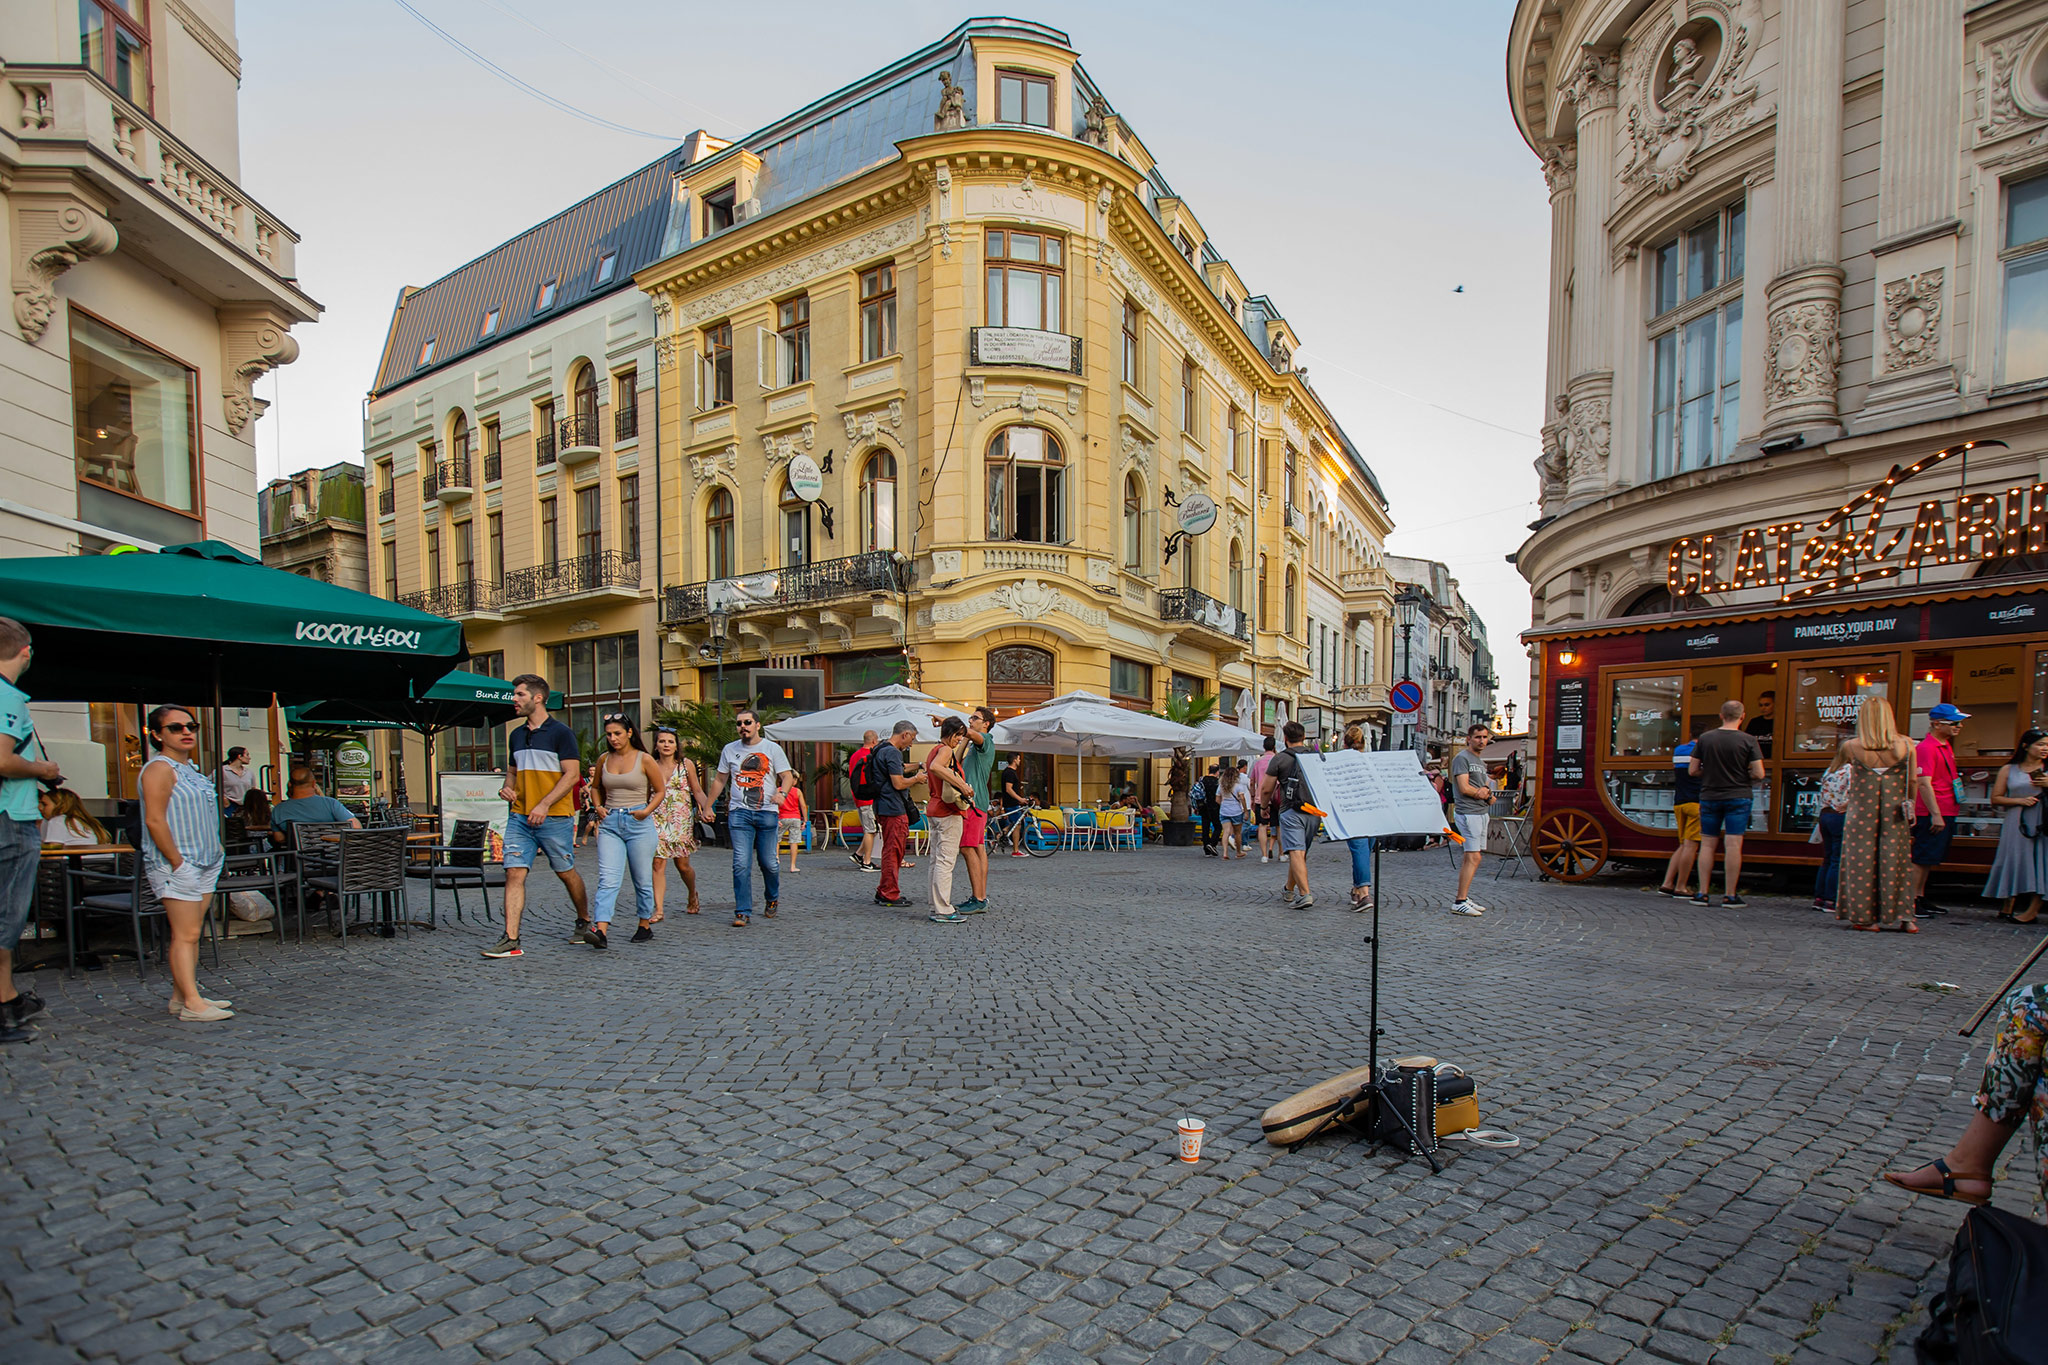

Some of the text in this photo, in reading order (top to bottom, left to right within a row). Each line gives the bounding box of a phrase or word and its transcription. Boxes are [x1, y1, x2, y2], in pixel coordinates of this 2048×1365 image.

[1668, 521, 1804, 597] CLAT
[1794, 618, 1897, 638] PANCAKES YOUR DAY
[475, 689, 500, 700] Bună
[1818, 706, 1844, 718] YOUR
